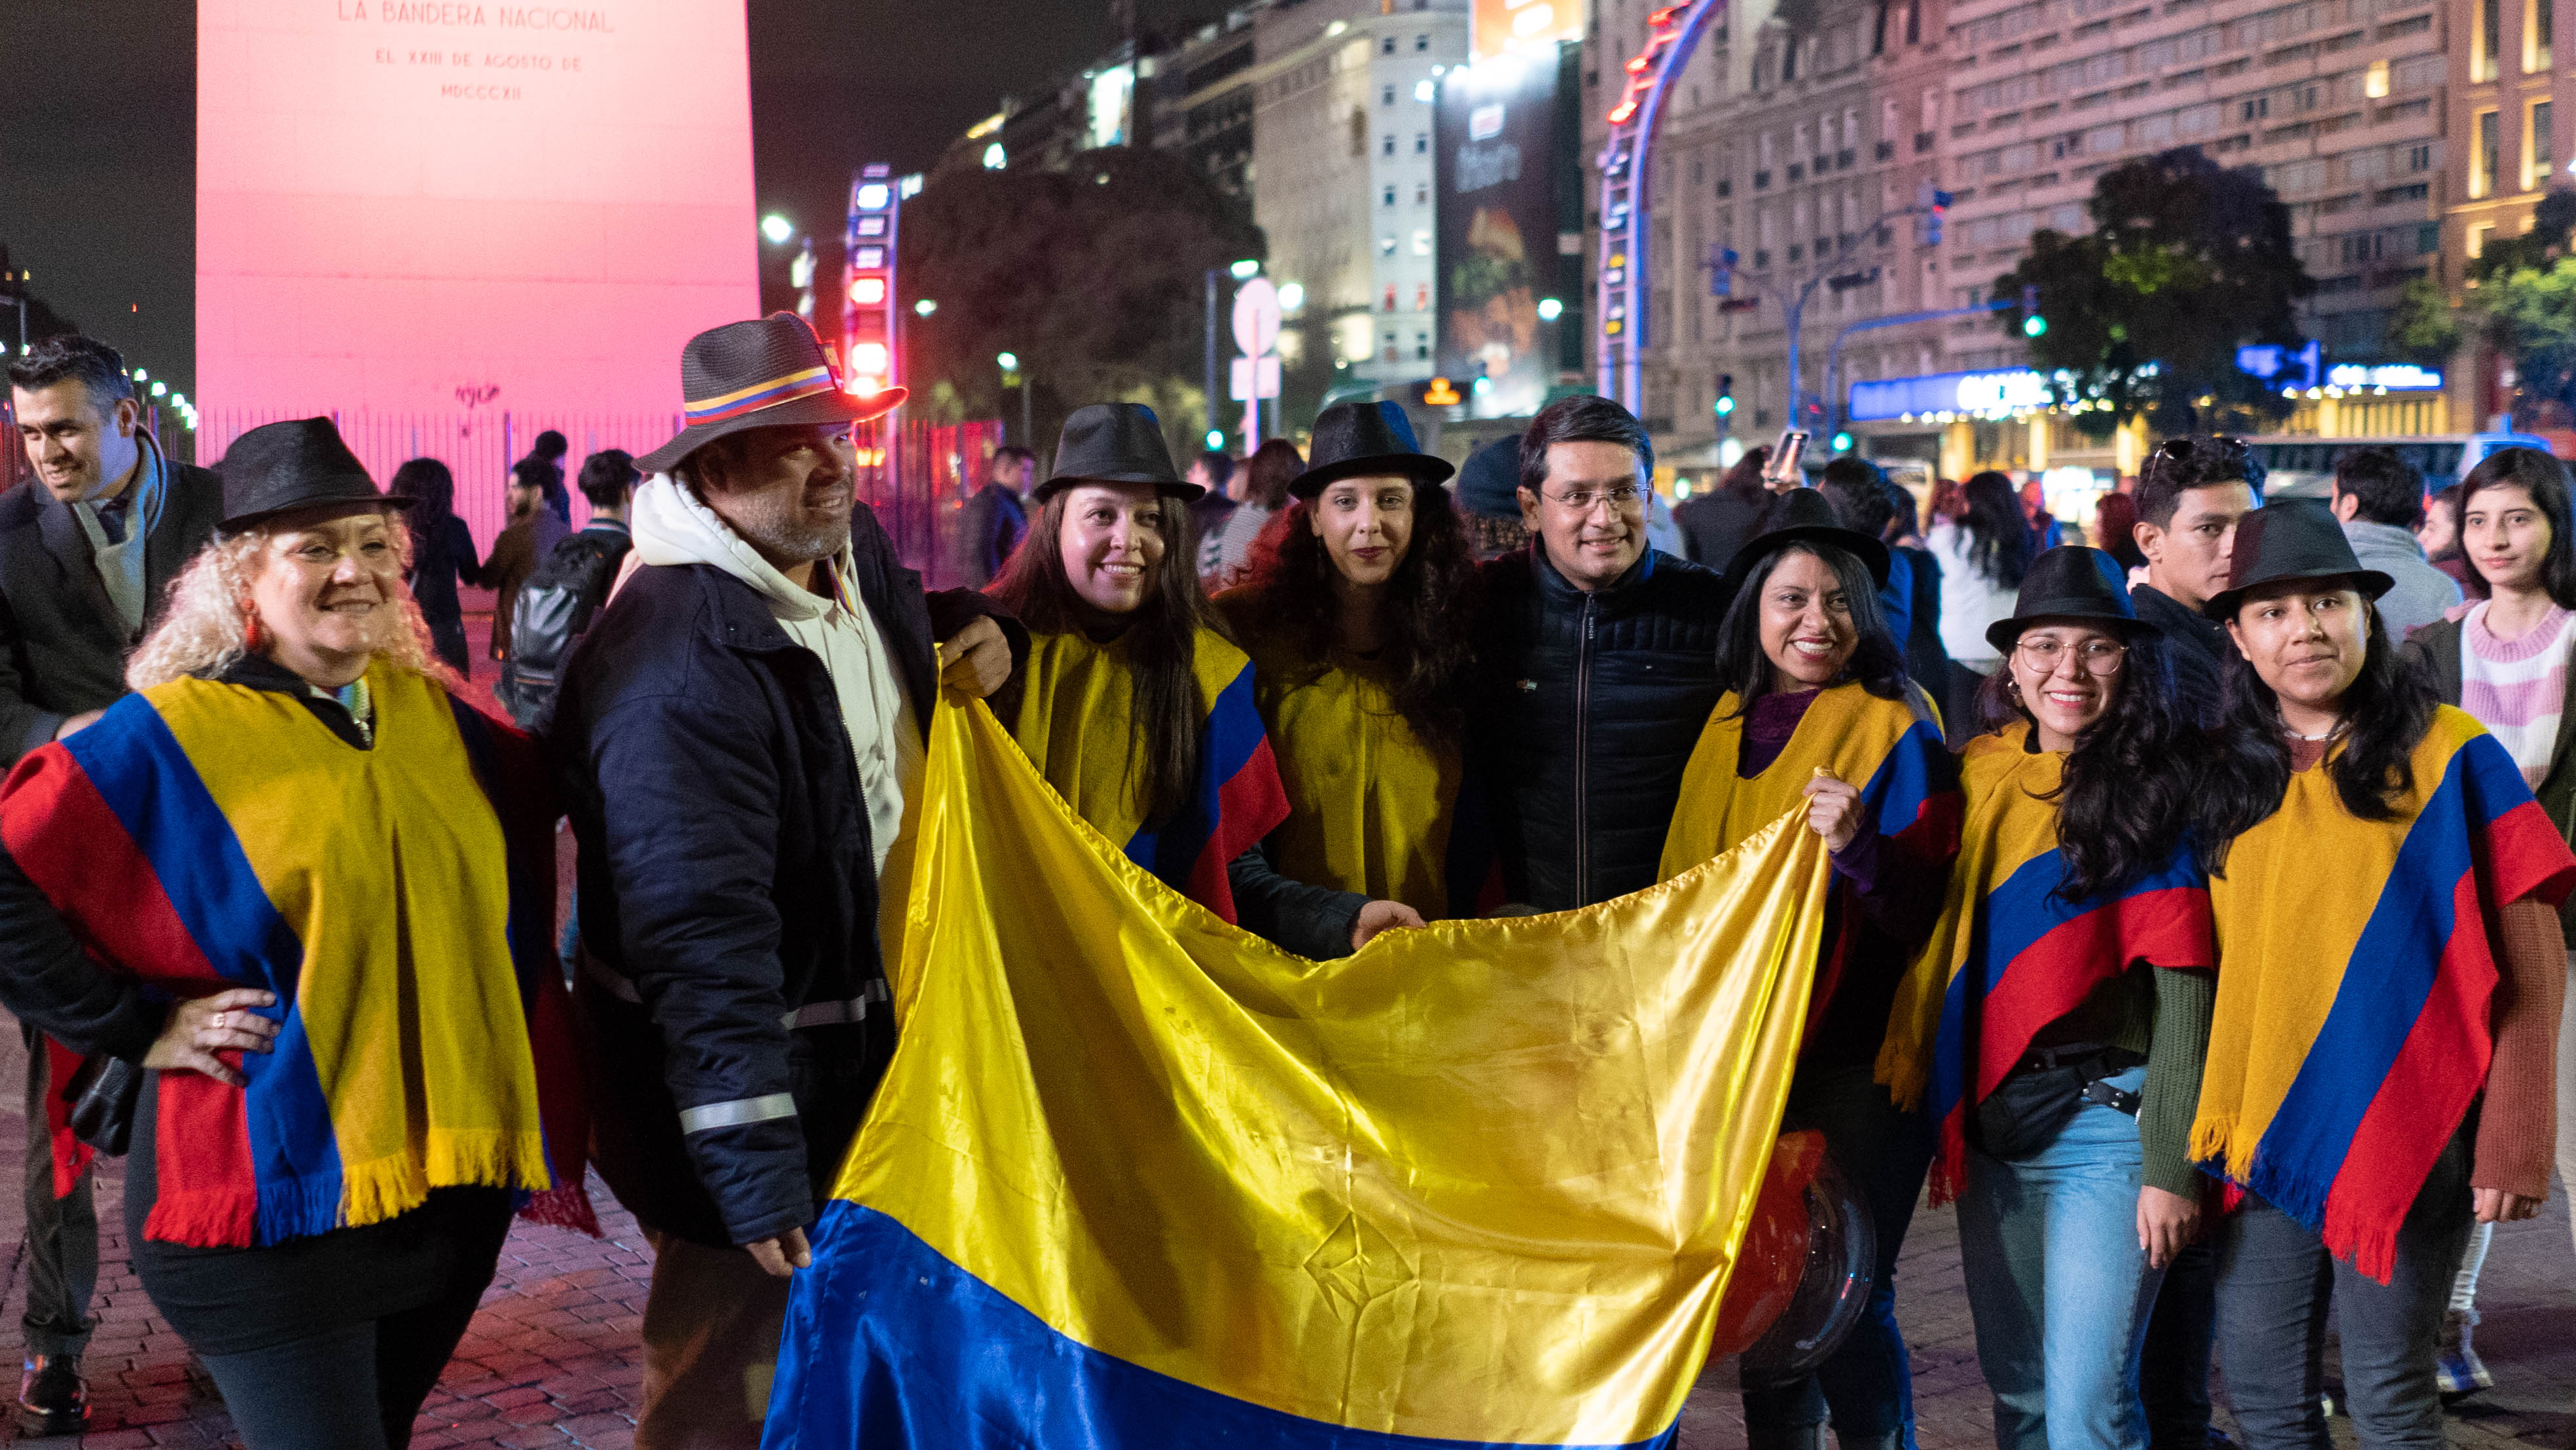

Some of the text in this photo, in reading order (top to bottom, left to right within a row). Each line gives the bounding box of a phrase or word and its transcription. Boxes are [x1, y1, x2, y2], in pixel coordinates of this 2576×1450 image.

[338, 0, 615, 33] LA BANDERA NACIONAL
[375, 48, 582, 71] EL XXIII DE AGOSTO DE
[441, 84, 522, 100] MDCCCXII
